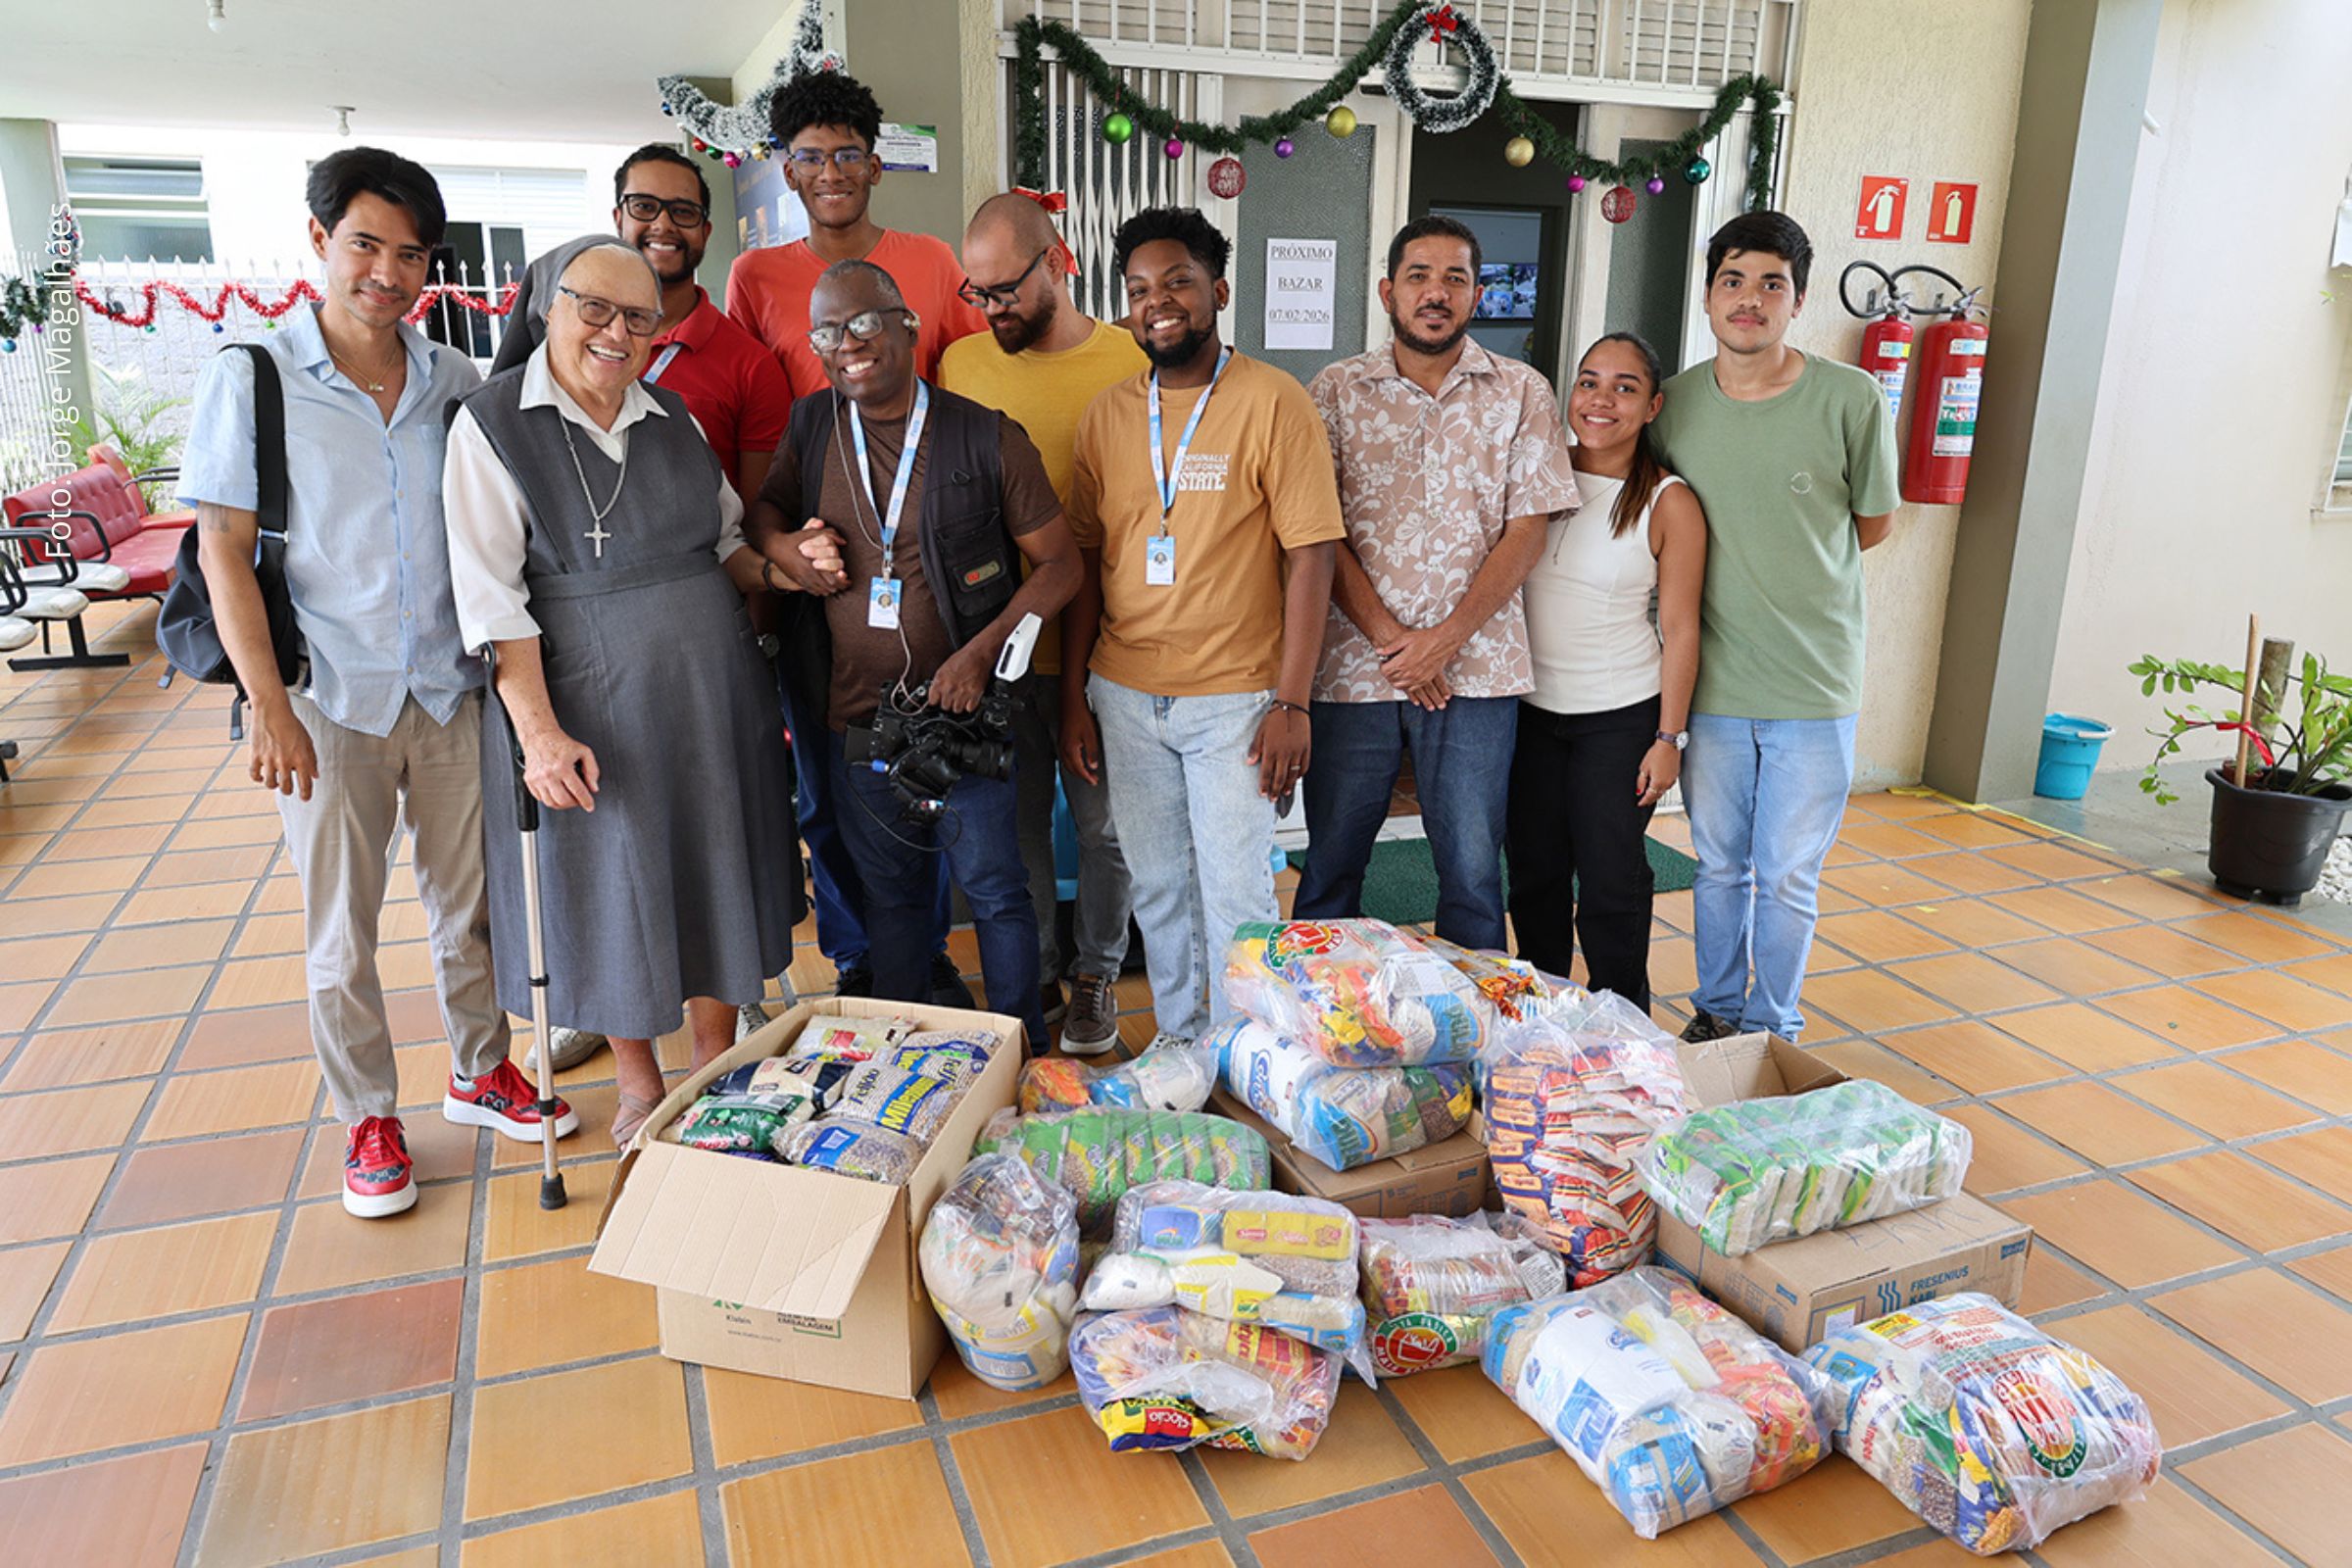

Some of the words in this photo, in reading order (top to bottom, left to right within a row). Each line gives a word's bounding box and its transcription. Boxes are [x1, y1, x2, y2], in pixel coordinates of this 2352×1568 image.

[1270, 242, 1334, 261] PRÓXIMO
[1278, 276, 1324, 291] BAZAR
[1269, 309, 1331, 323] 07/02/2026
[1178, 470, 1227, 491] STATE
[1910, 1265, 1970, 1292] FRESENIUS
